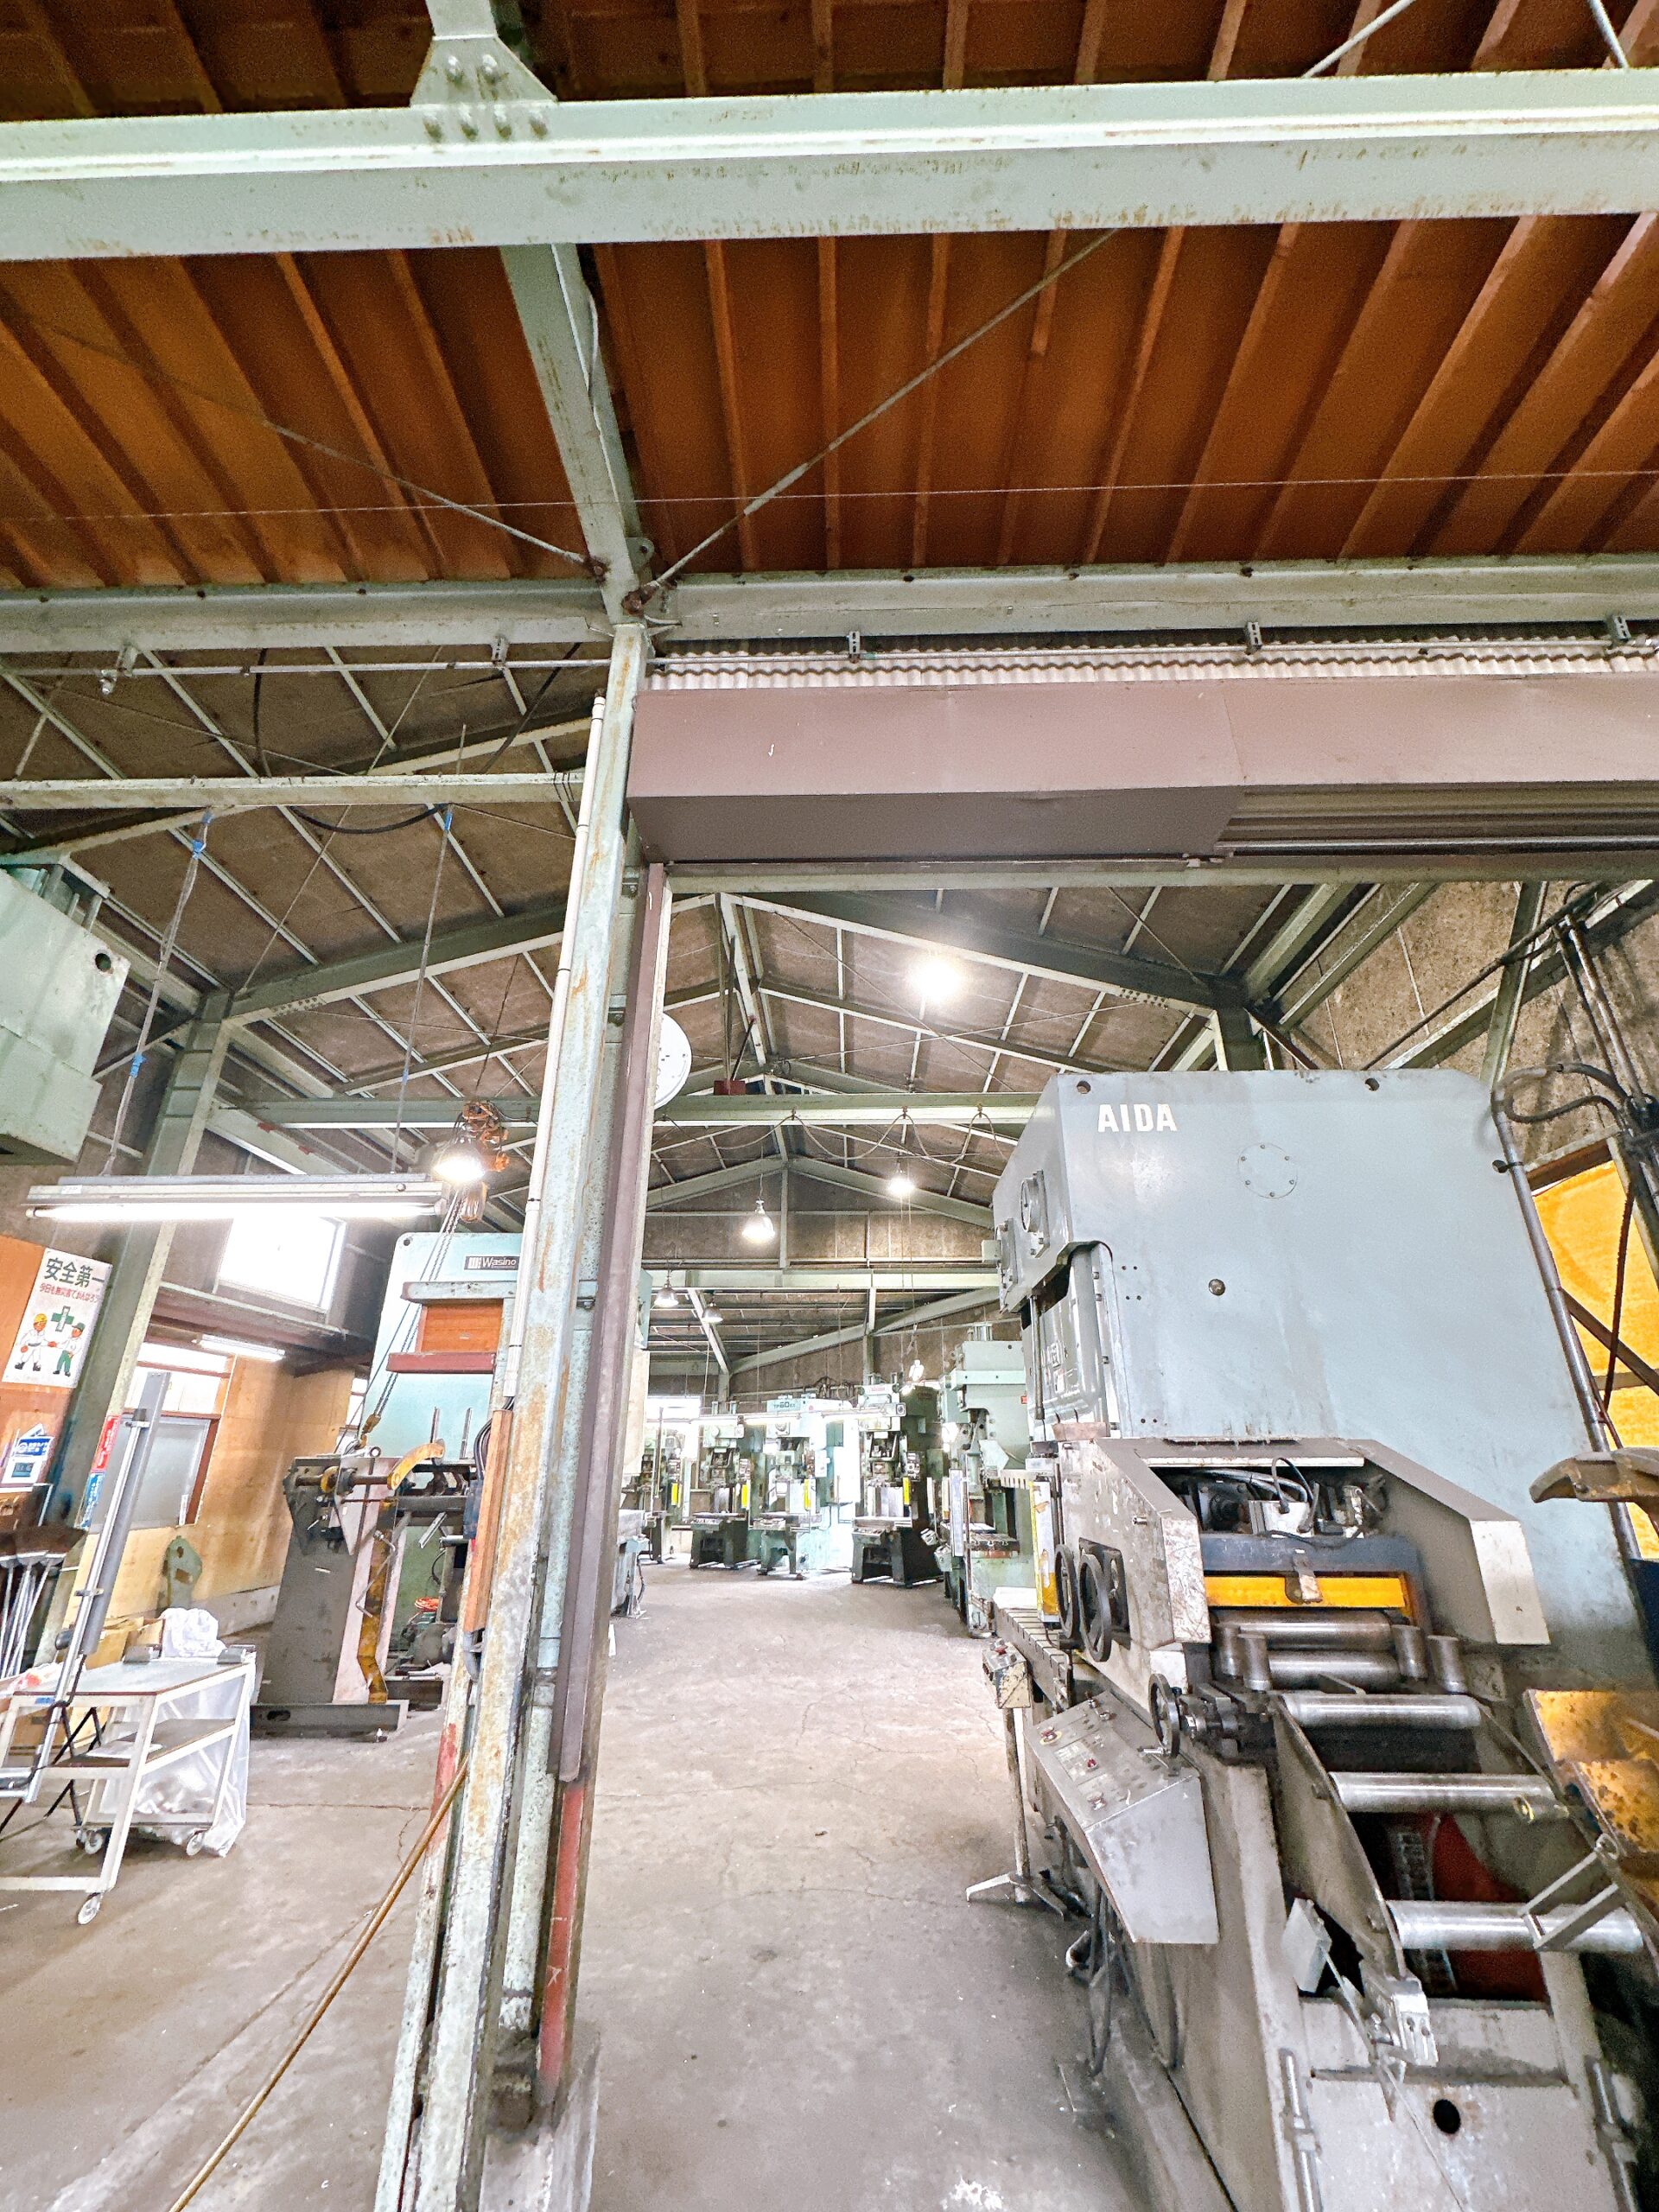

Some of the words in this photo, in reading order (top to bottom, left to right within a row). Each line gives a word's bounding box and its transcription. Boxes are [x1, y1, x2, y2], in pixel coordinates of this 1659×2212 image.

[1097, 1103, 1179, 1133] AIDA
[44, 1257, 105, 1288] 安全第一
[482, 1256, 517, 1268] Wasino
